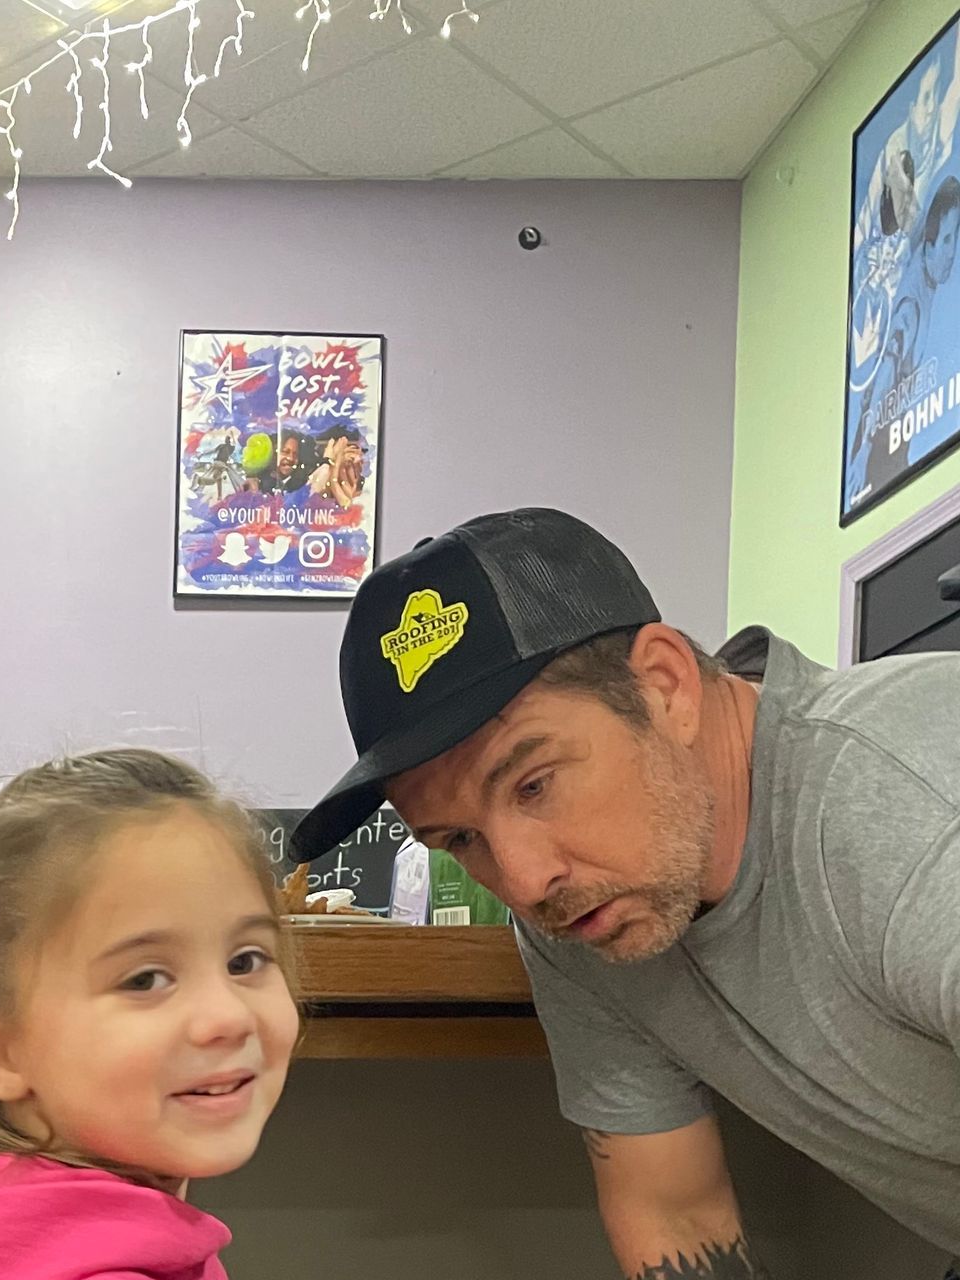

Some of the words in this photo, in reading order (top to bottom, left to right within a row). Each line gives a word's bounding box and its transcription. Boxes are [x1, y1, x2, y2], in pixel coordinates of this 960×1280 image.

[279, 351, 354, 371] BOWL.
[277, 374, 340, 395] POST.
[862, 357, 937, 437] PARKER
[889, 385, 944, 455] BOHN
[218, 507, 335, 525] @YOUTH_BOWLING
[388, 612, 460, 650] ROOFING
[397, 643, 409, 656] IN
[411, 634, 435, 649] THE
[438, 625, 456, 638] 207
